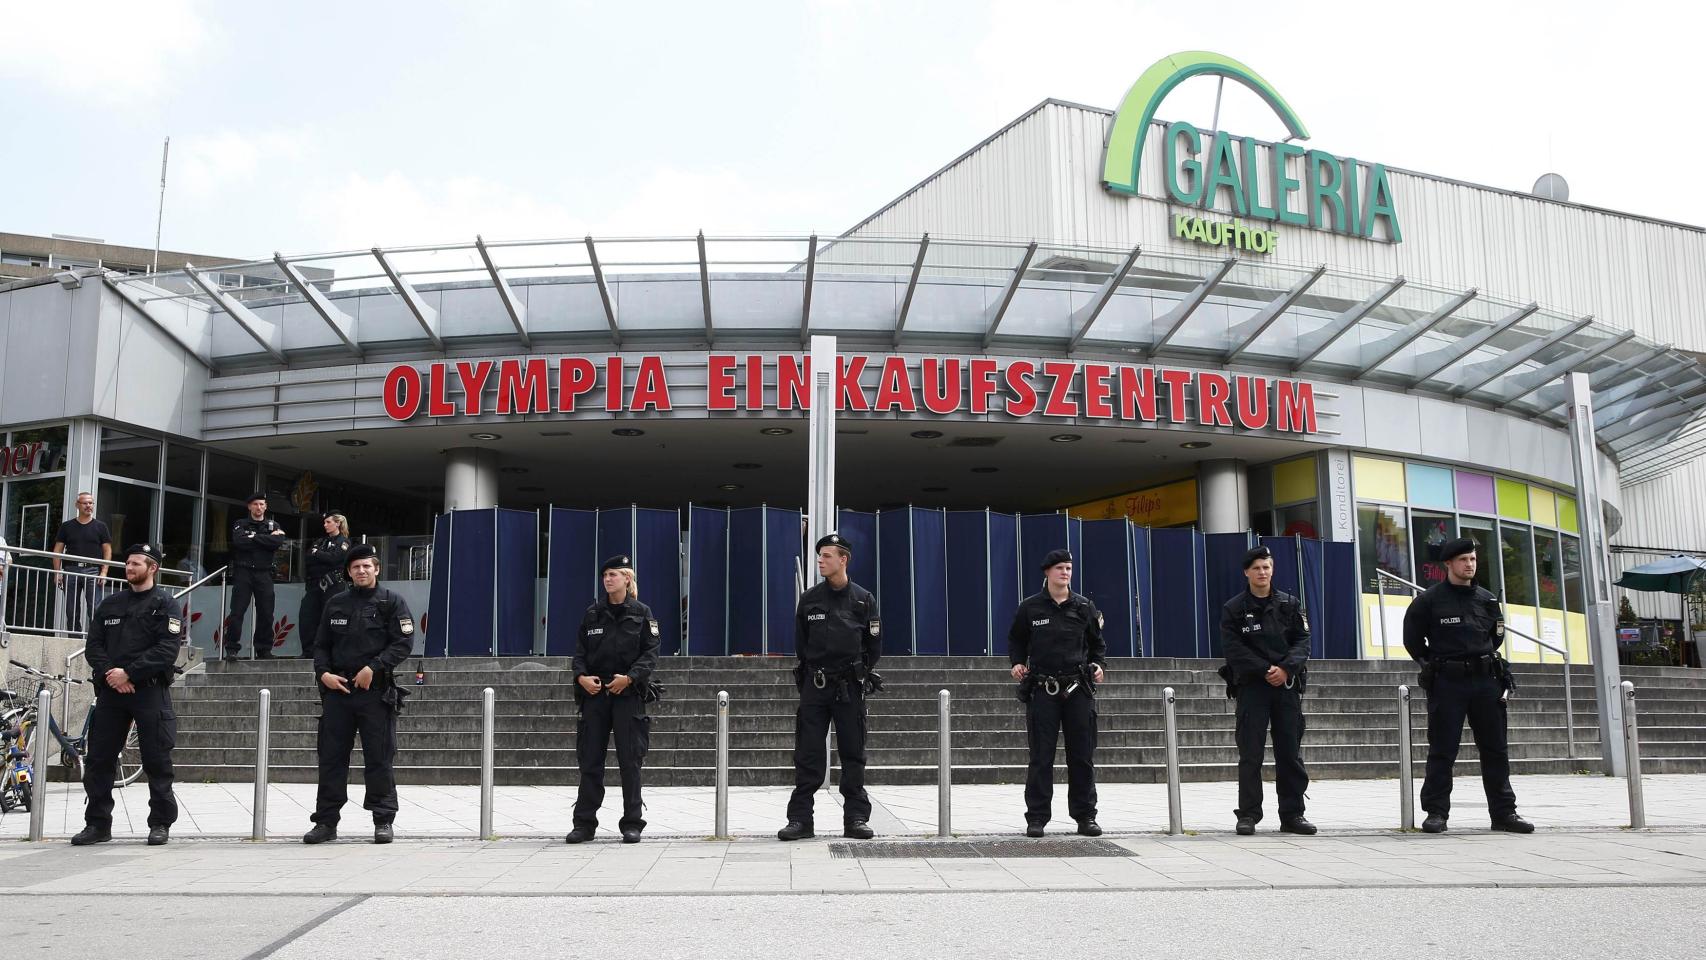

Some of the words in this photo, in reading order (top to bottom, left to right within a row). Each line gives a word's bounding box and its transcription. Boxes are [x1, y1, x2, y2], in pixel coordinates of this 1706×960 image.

[1166, 119, 1402, 243] GALERIA
[383, 355, 673, 422] OLYMPIA
[707, 353, 1319, 435] EINKAUFSZENTRUM
[1334, 459, 1348, 530] Konditorei
